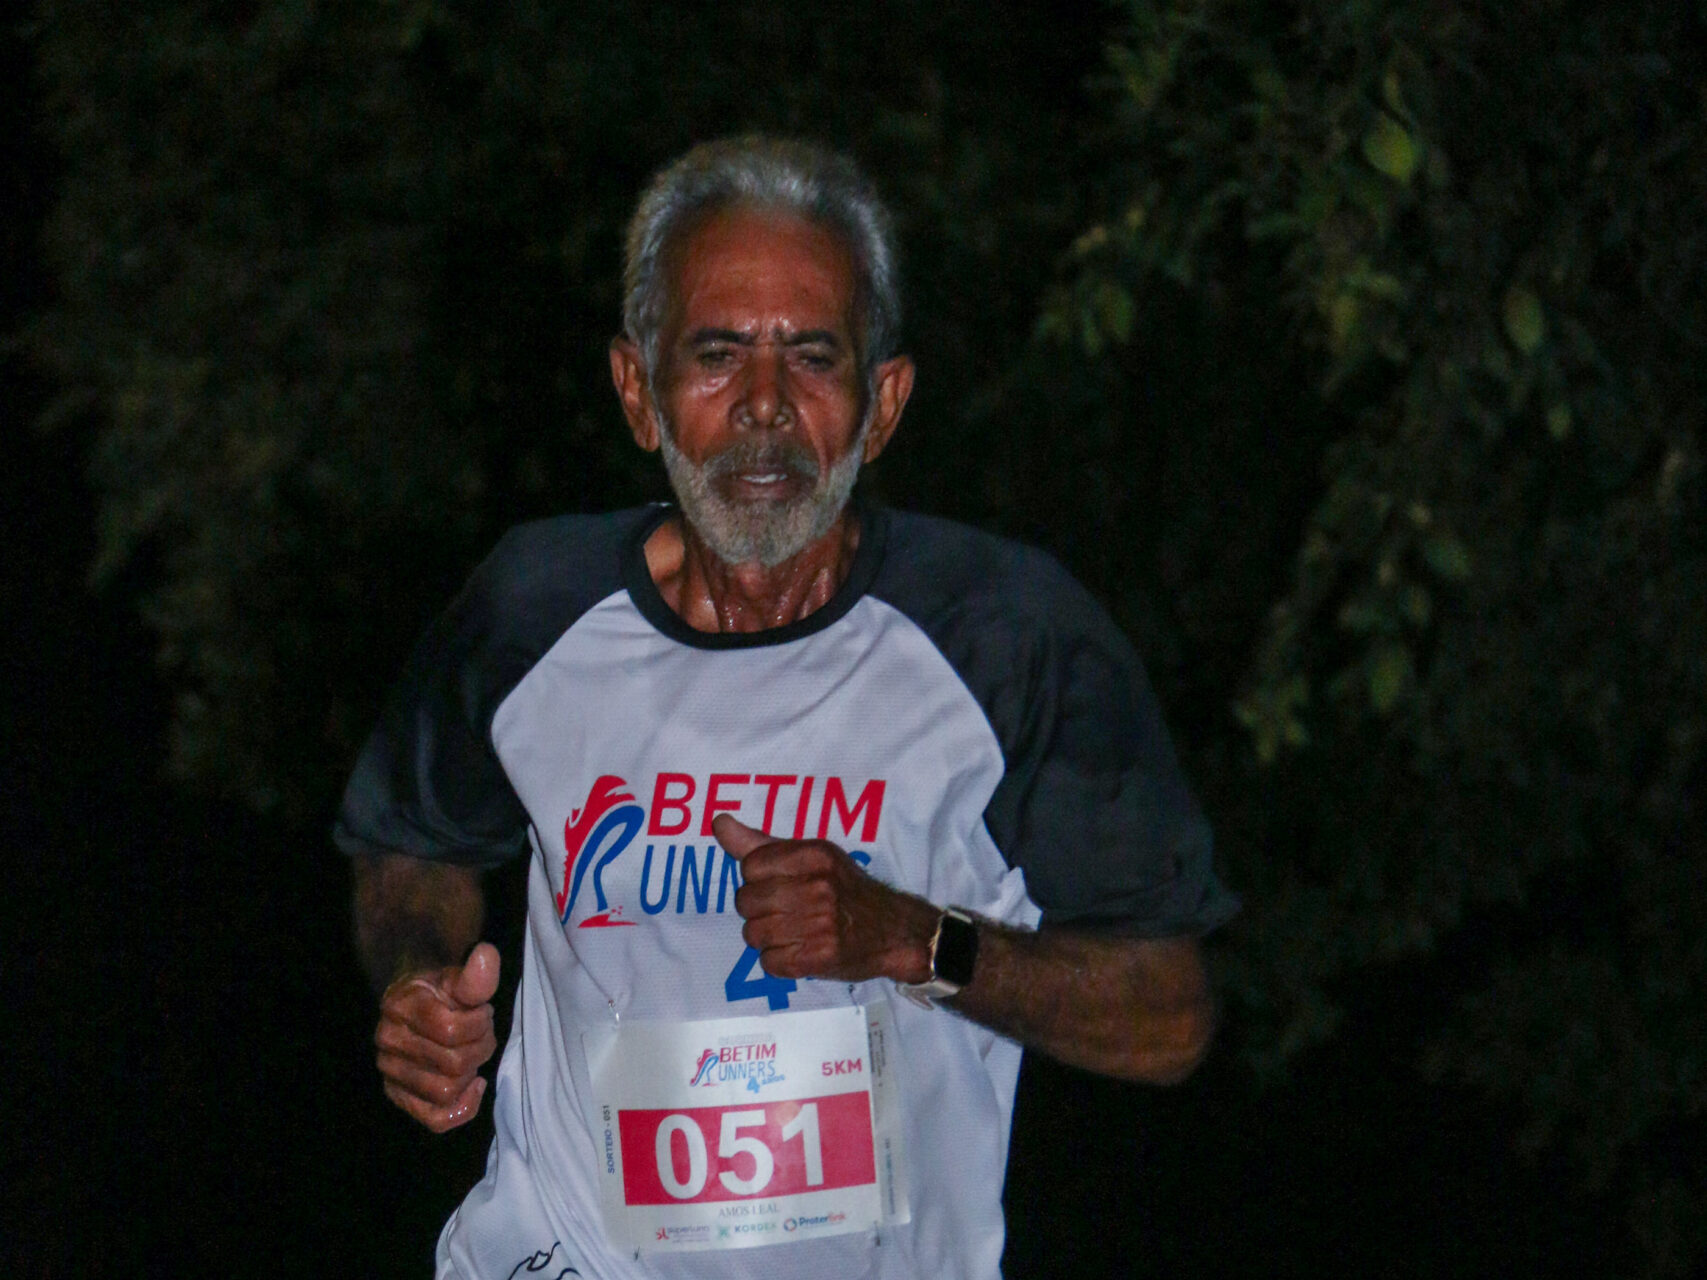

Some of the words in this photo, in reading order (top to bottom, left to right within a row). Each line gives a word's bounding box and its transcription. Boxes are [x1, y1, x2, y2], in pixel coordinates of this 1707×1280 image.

[647, 772, 887, 843] BETIM
[725, 945, 797, 1011] 4
[719, 1043, 777, 1063] BETIM
[821, 1058, 863, 1077] 5KM
[604, 1129, 615, 1175] SORTEIO
[655, 1102, 825, 1200] 051
